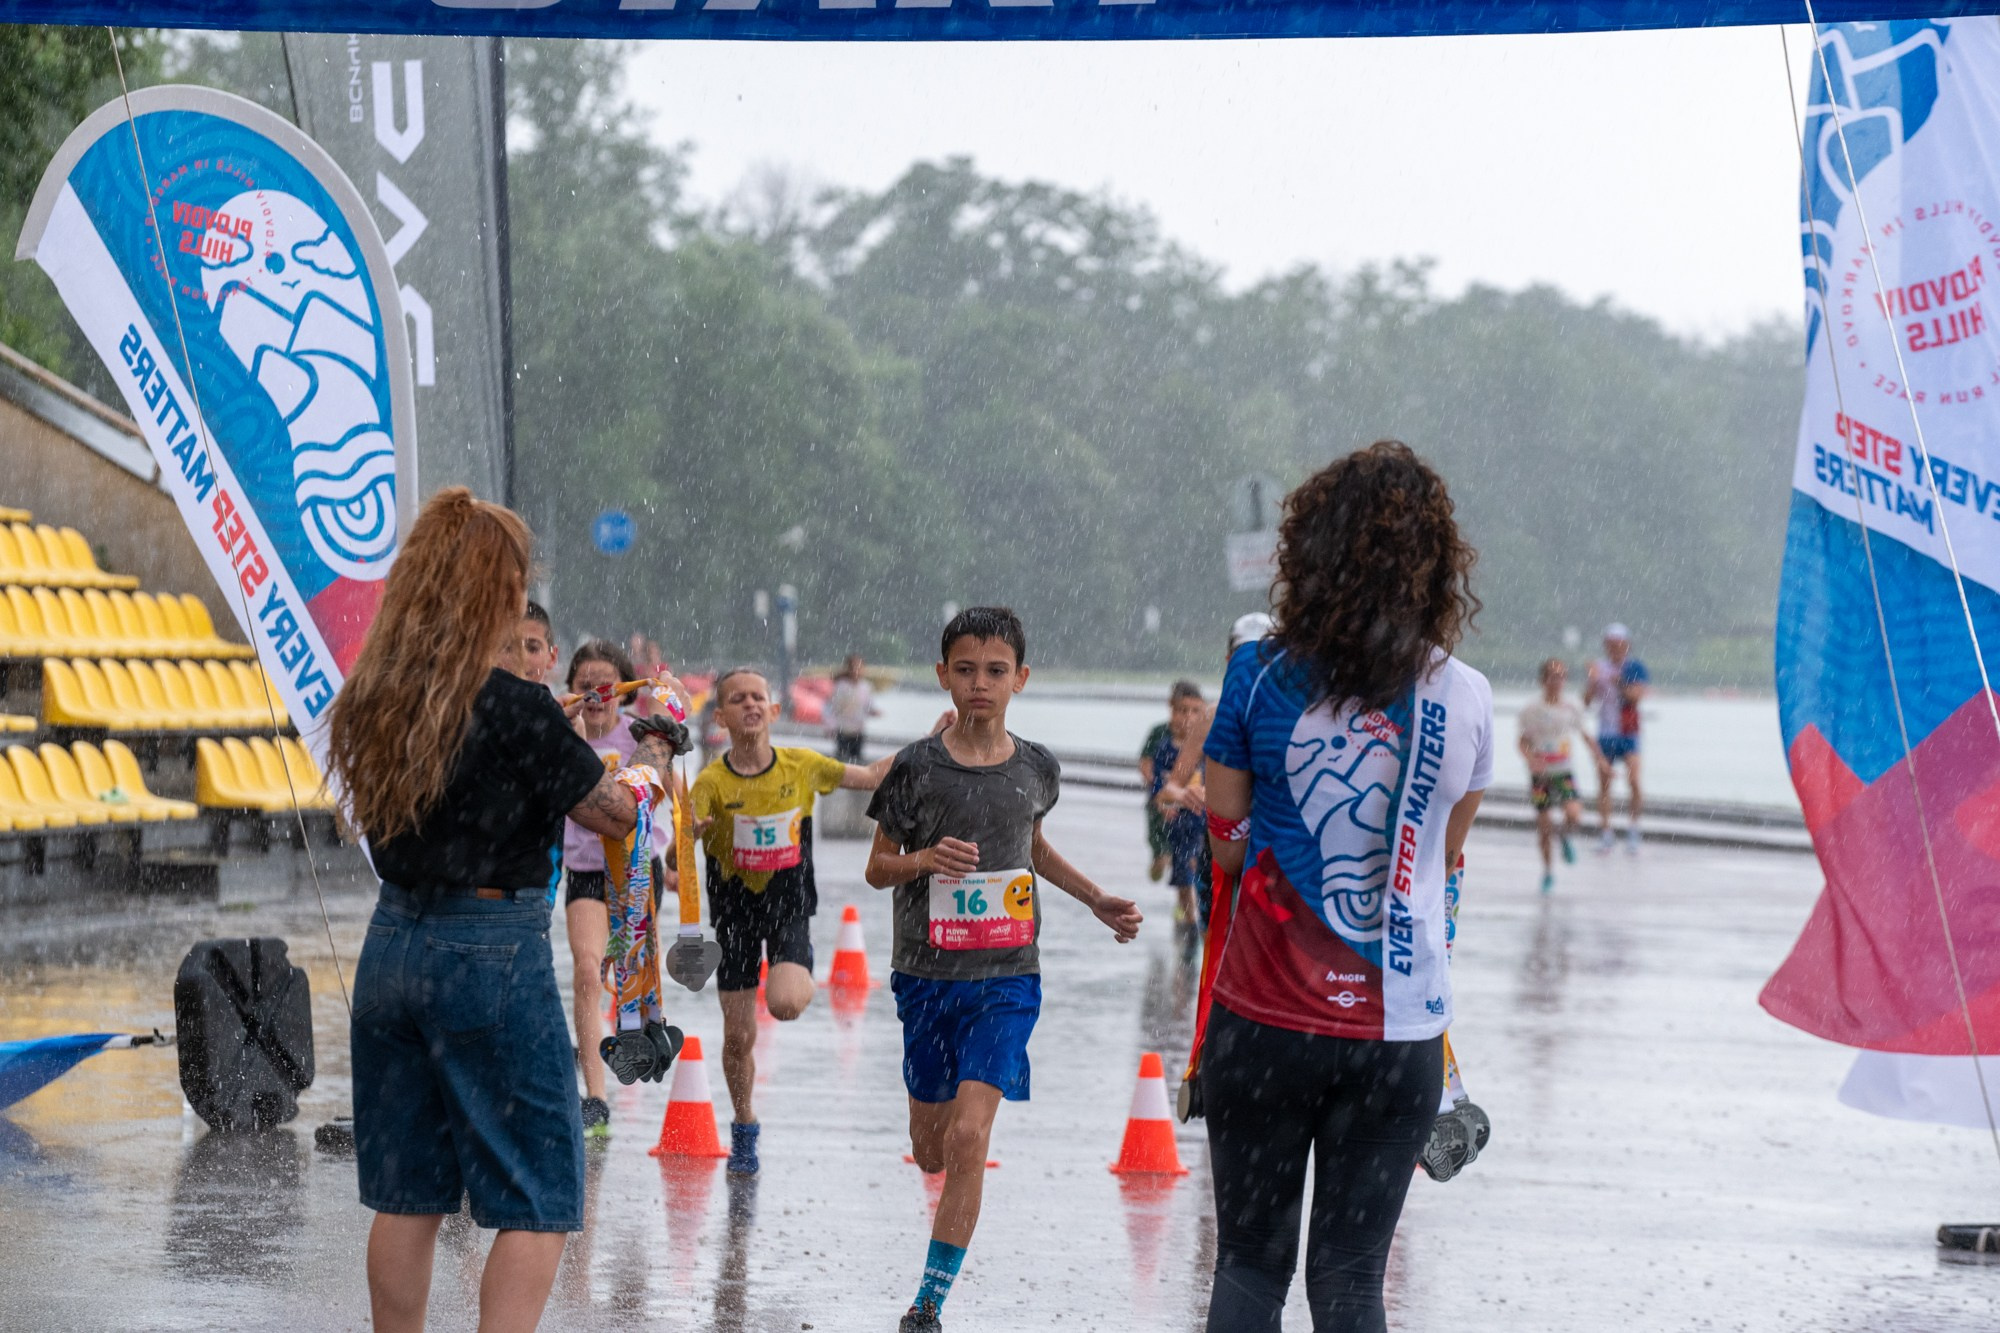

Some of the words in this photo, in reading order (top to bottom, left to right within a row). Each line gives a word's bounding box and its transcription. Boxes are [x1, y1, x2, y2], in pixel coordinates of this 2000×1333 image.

[1404, 697, 1448, 827] MATTERS
[752, 826, 776, 847] 15
[1393, 822, 1419, 898] STEP
[951, 888, 988, 916] 16
[1388, 892, 1414, 978] EVERY
[1338, 973, 1367, 982] AIGER
